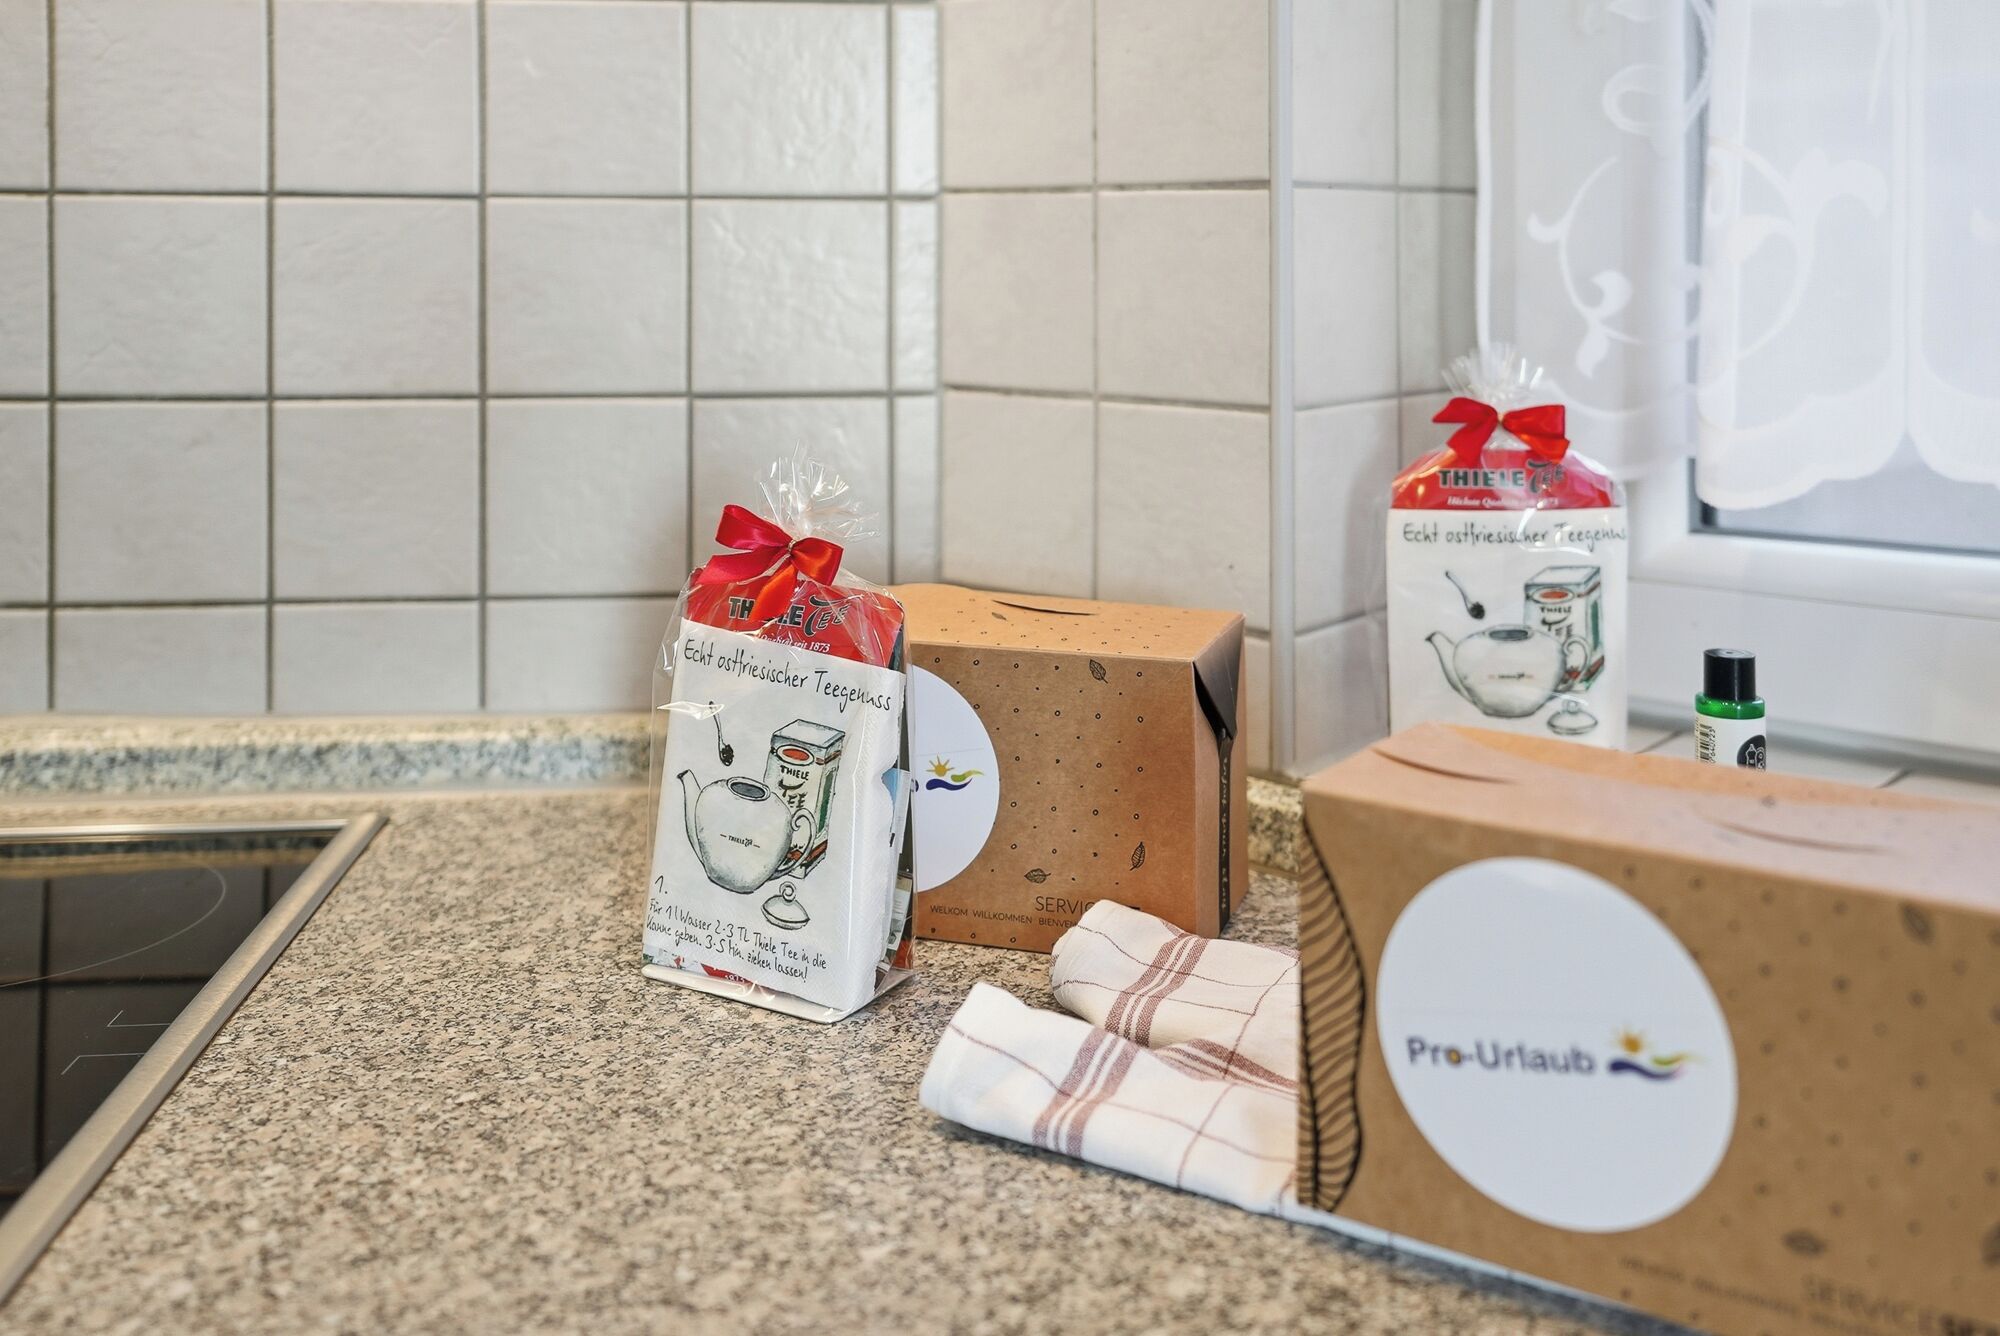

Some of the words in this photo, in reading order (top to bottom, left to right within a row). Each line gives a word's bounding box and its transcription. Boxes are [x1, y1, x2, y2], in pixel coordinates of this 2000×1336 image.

[1438, 468, 1525, 489] THIELE
[1403, 522, 1437, 543] Echt
[1446, 522, 1547, 546] ostfriesischer
[728, 597, 806, 628] THLE
[684, 639, 713, 667] Echt
[717, 648, 808, 688] ostfriesischer
[814, 671, 891, 713] Teegenuss
[780, 765, 809, 780] THIELE
[655, 876, 668, 893] 1.
[929, 905, 968, 917] WELKOM
[972, 910, 1033, 924] WILLKOMMEN
[680, 909, 712, 931] Wasser
[737, 927, 750, 942] TL
[753, 932, 777, 954] Thiele
[781, 942, 799, 960] Tee
[802, 949, 810, 963] in
[813, 953, 827, 969] die
[747, 950, 772, 970] ziehen
[774, 957, 808, 983] lassen!
[1405, 1036, 1596, 1075] Pro-Urlaub
